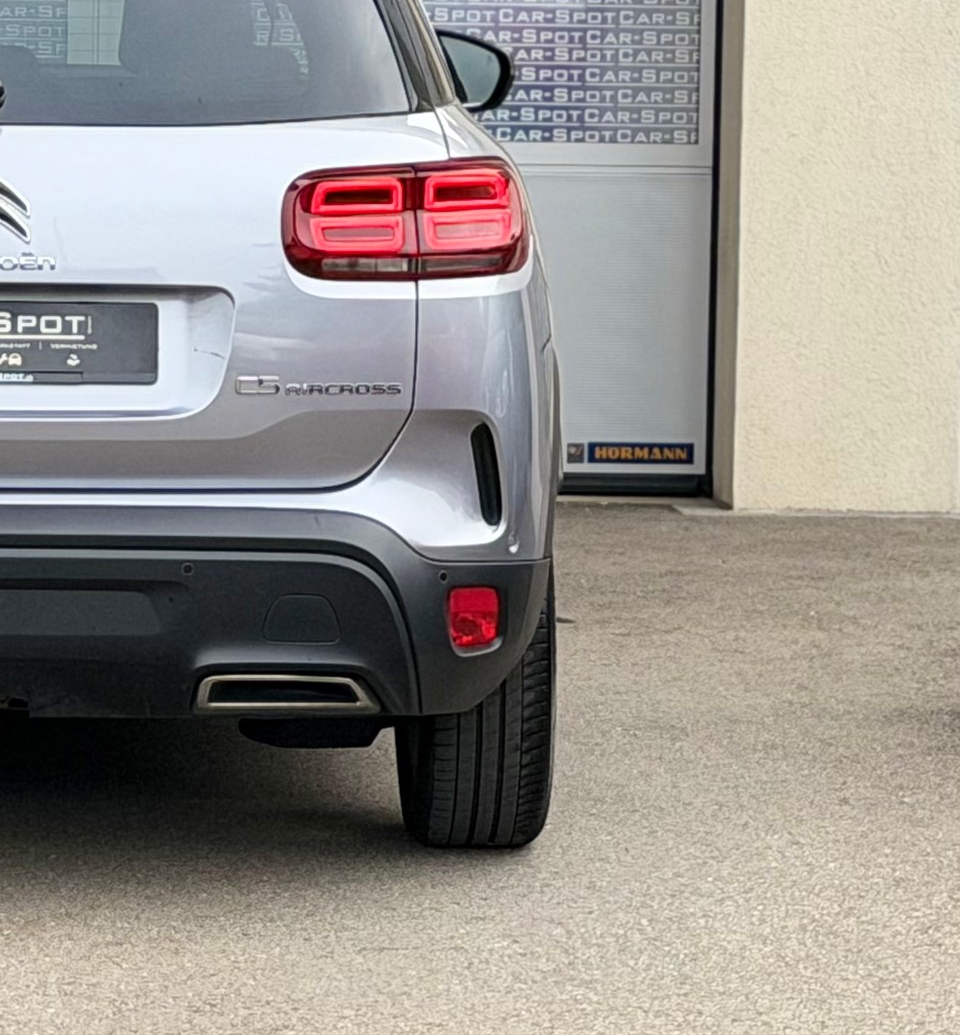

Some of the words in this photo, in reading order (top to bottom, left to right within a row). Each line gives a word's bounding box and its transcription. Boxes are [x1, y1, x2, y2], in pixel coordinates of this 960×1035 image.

[498, 9, 616, 23] CAR-SPOT
[507, 87, 614, 102] AR-SPOT
[481, 107, 581, 121] AR-SPOT
[496, 128, 614, 141] CAR-SPOT
